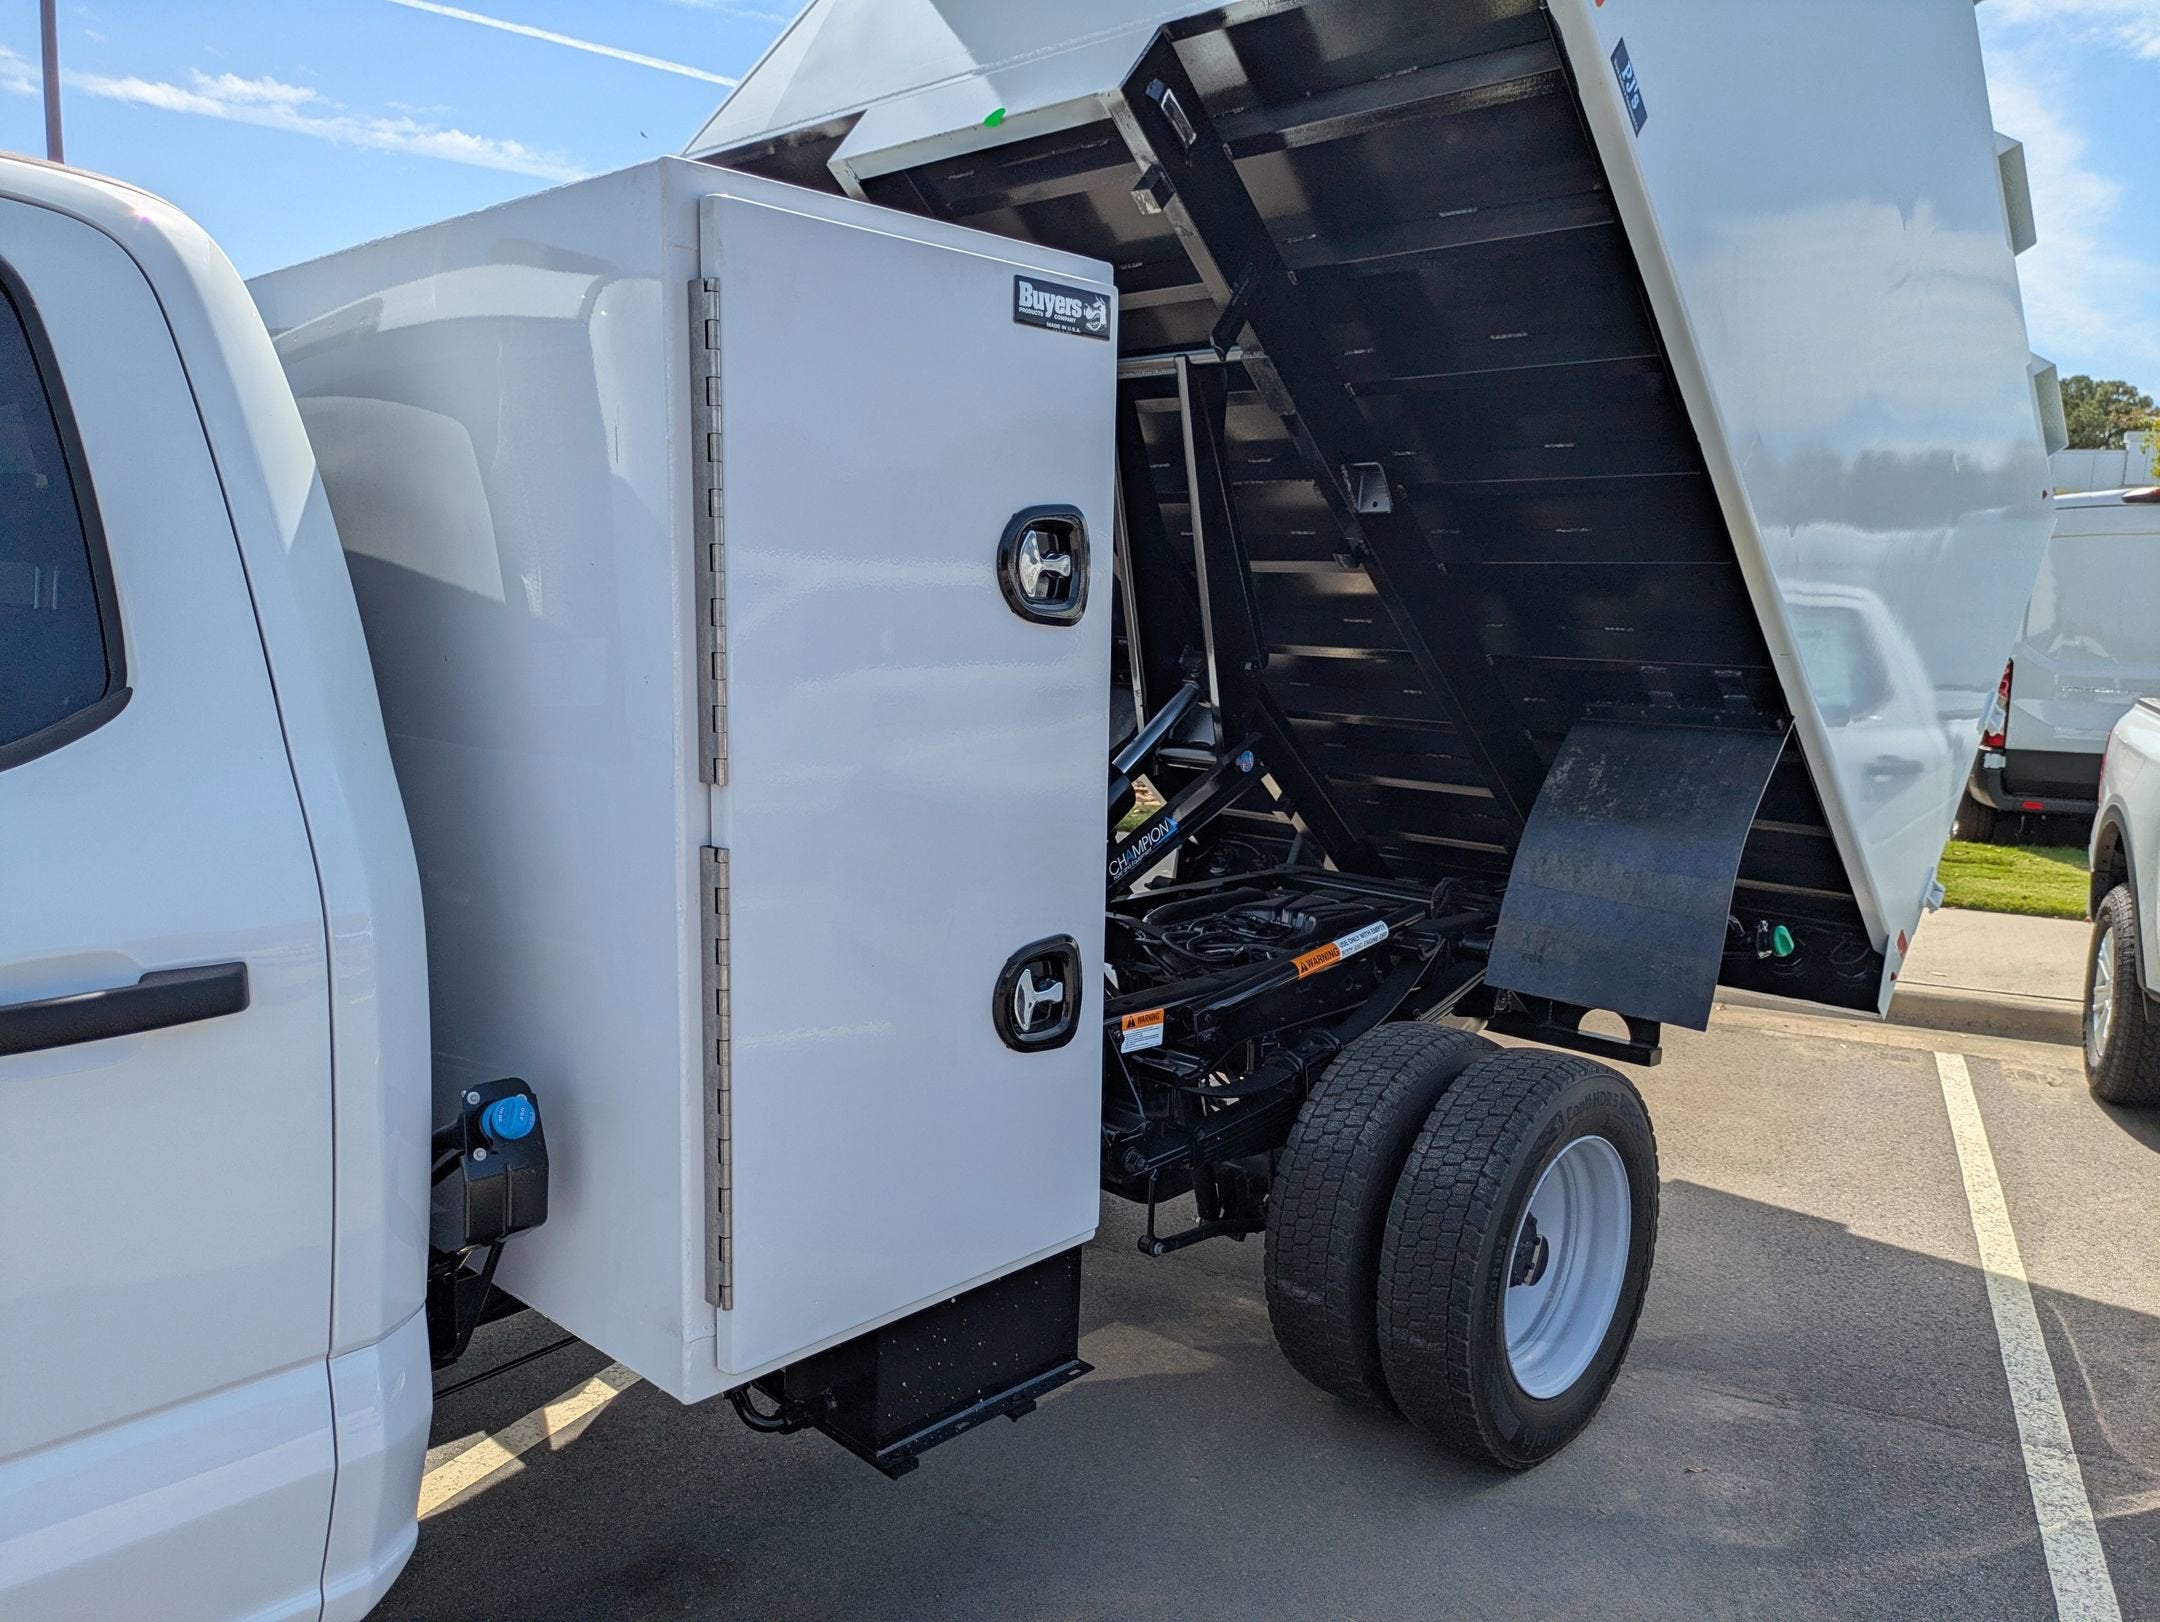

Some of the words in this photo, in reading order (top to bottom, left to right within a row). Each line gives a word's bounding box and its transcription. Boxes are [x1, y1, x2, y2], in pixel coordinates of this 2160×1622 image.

[1622, 62, 1640, 109] PJ's
[1018, 281, 1082, 318] Buyers
[1018, 306, 1043, 317] PRODUCTS
[1054, 313, 1077, 323] COMPANY
[1046, 321, 1060, 330] MADE
[1108, 820, 1170, 876] CHAMPION
[1306, 947, 1340, 968] WARNING
[1137, 1012, 1160, 1024] WARNING
